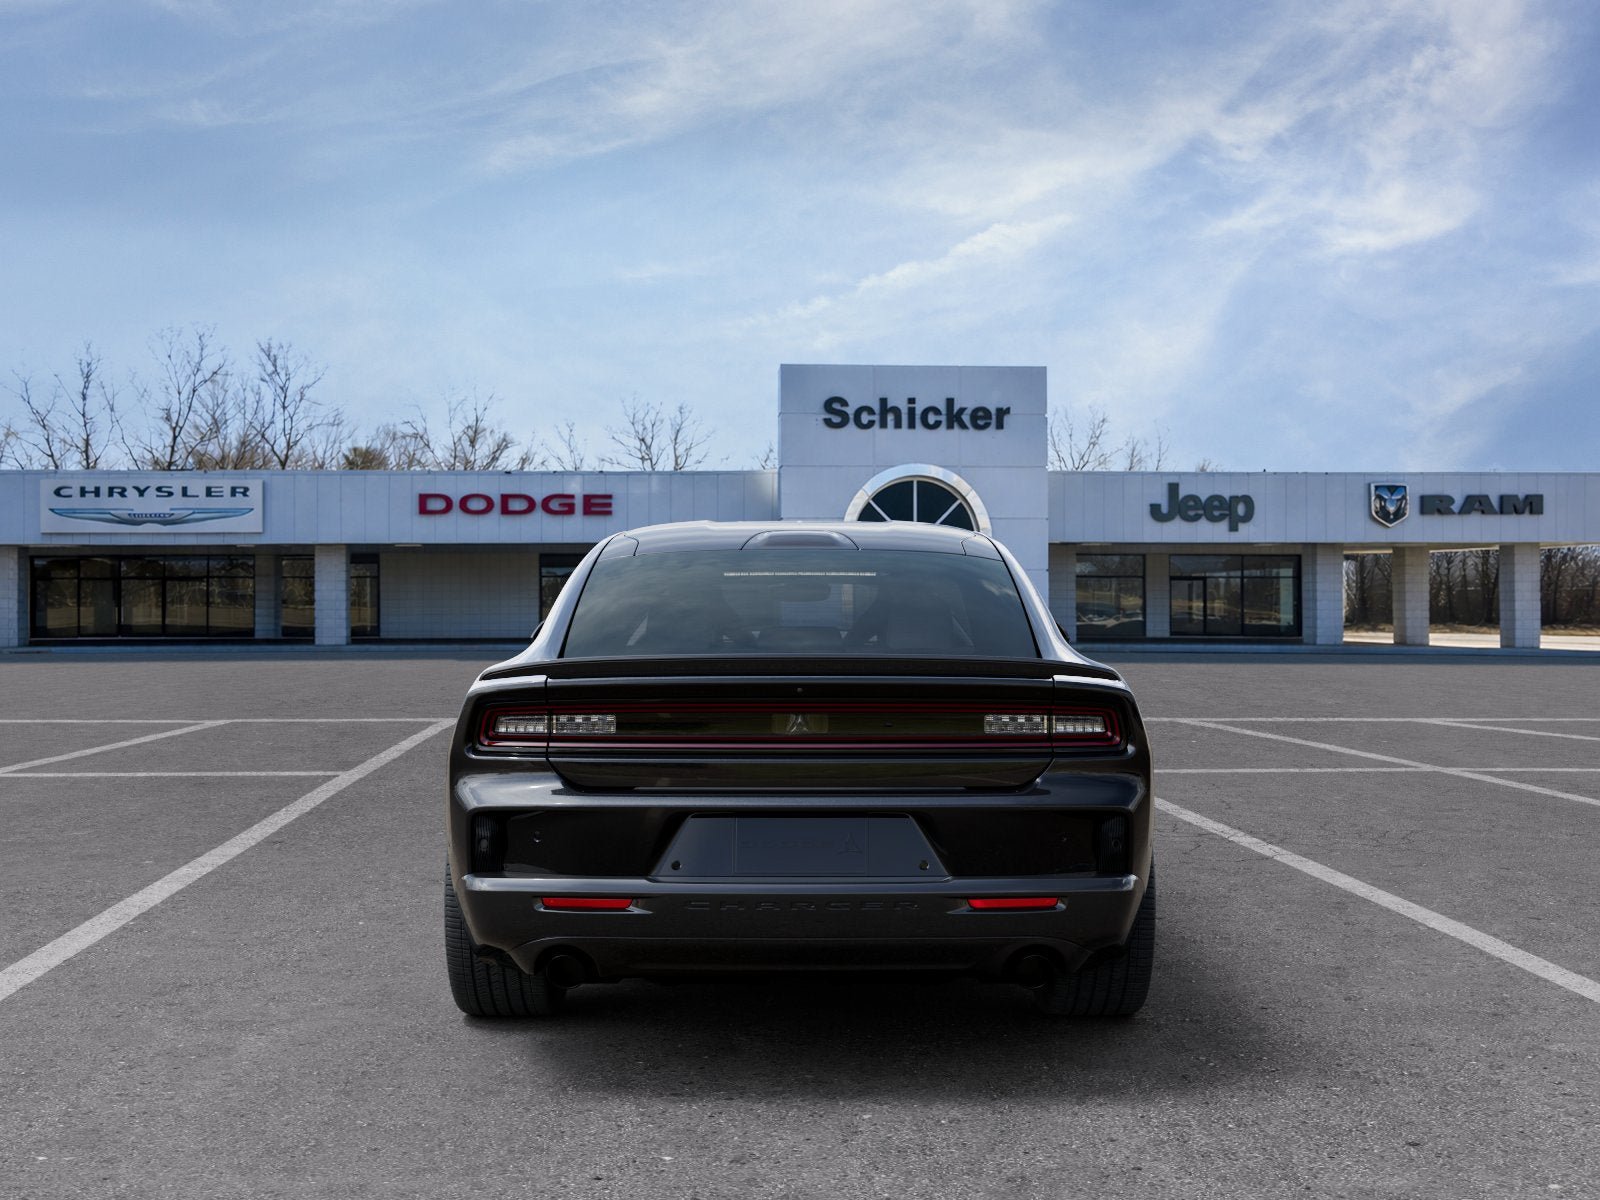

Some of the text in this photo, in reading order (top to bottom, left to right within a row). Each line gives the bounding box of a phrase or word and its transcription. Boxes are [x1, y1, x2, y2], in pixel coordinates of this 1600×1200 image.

[822, 395, 1011, 431] Schicker
[53, 485, 250, 499] CHRYSLER
[418, 493, 613, 517] DODGE
[1149, 482, 1255, 533] Jeep
[1420, 494, 1545, 516] RAM
